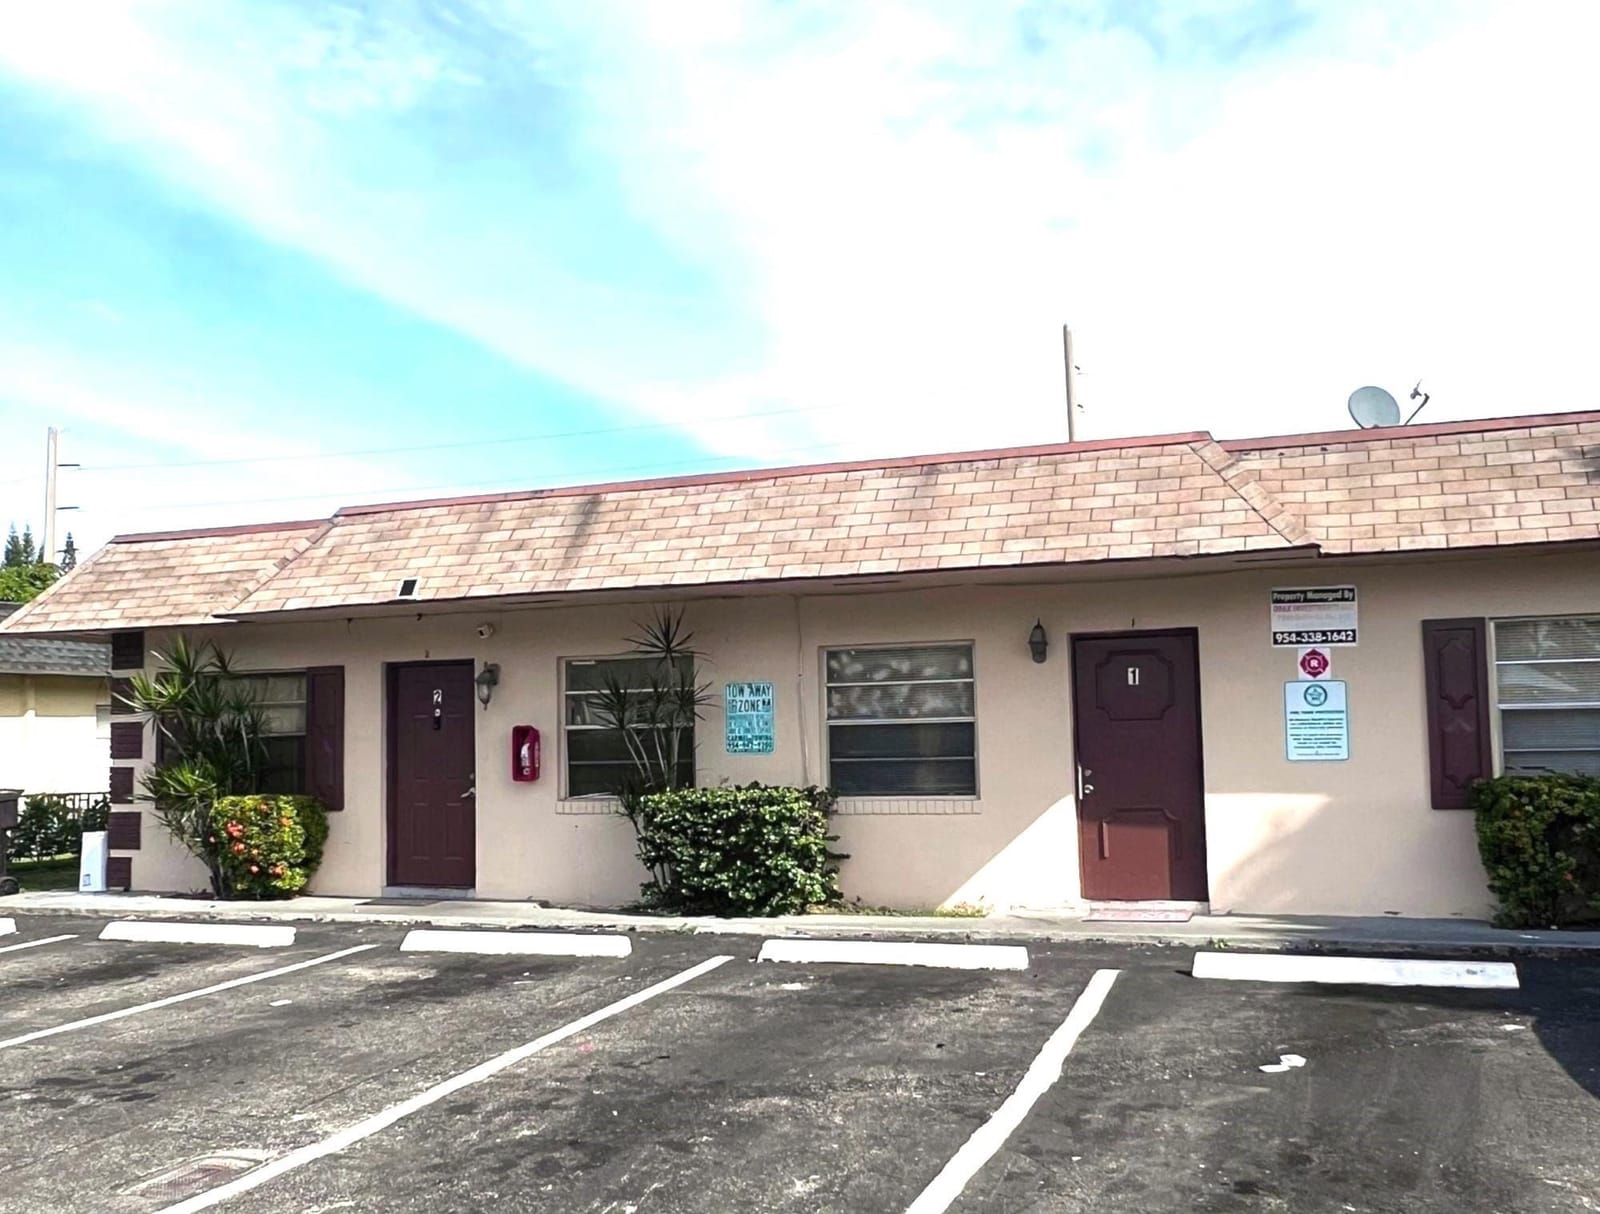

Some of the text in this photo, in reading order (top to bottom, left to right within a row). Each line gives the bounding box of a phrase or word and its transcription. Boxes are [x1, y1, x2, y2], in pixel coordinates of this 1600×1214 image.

[1273, 589, 1354, 602] Property Managed By
[1275, 631, 1354, 643] 954-338-1642
[1310, 659, 1320, 668] R
[749, 683, 771, 697] AWAY
[738, 699, 761, 713] ZONE
